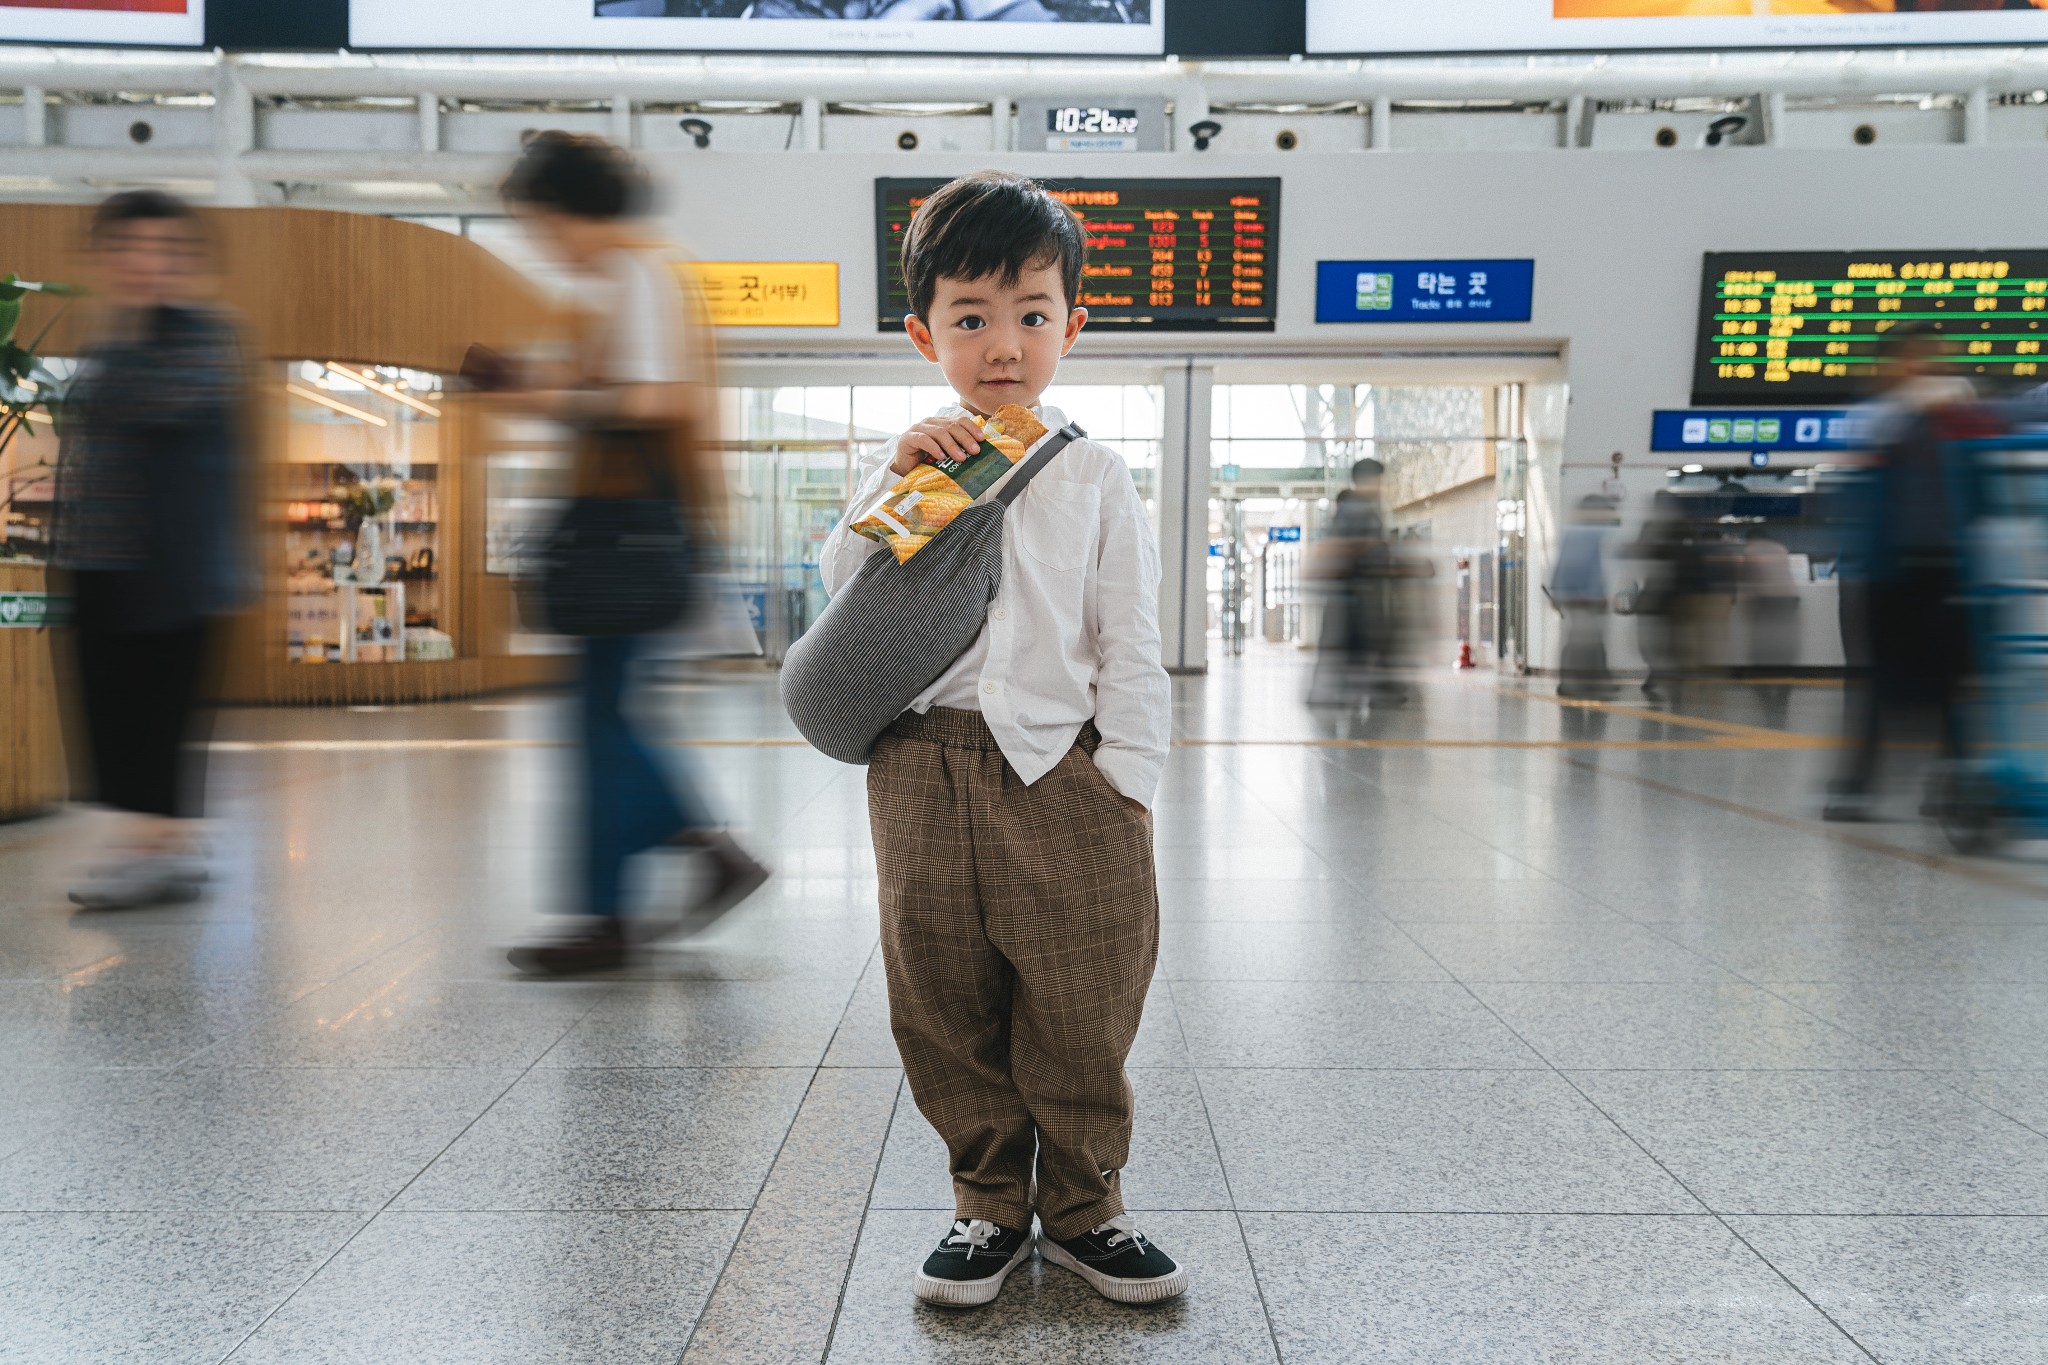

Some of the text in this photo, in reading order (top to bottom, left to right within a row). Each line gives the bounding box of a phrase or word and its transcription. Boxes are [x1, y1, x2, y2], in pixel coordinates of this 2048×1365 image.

[1056, 107, 1118, 133] 10:26
[1199, 263, 1209, 276] 7
[1196, 278, 1210, 291] 11
[1418, 272, 1487, 295] 타는 곳
